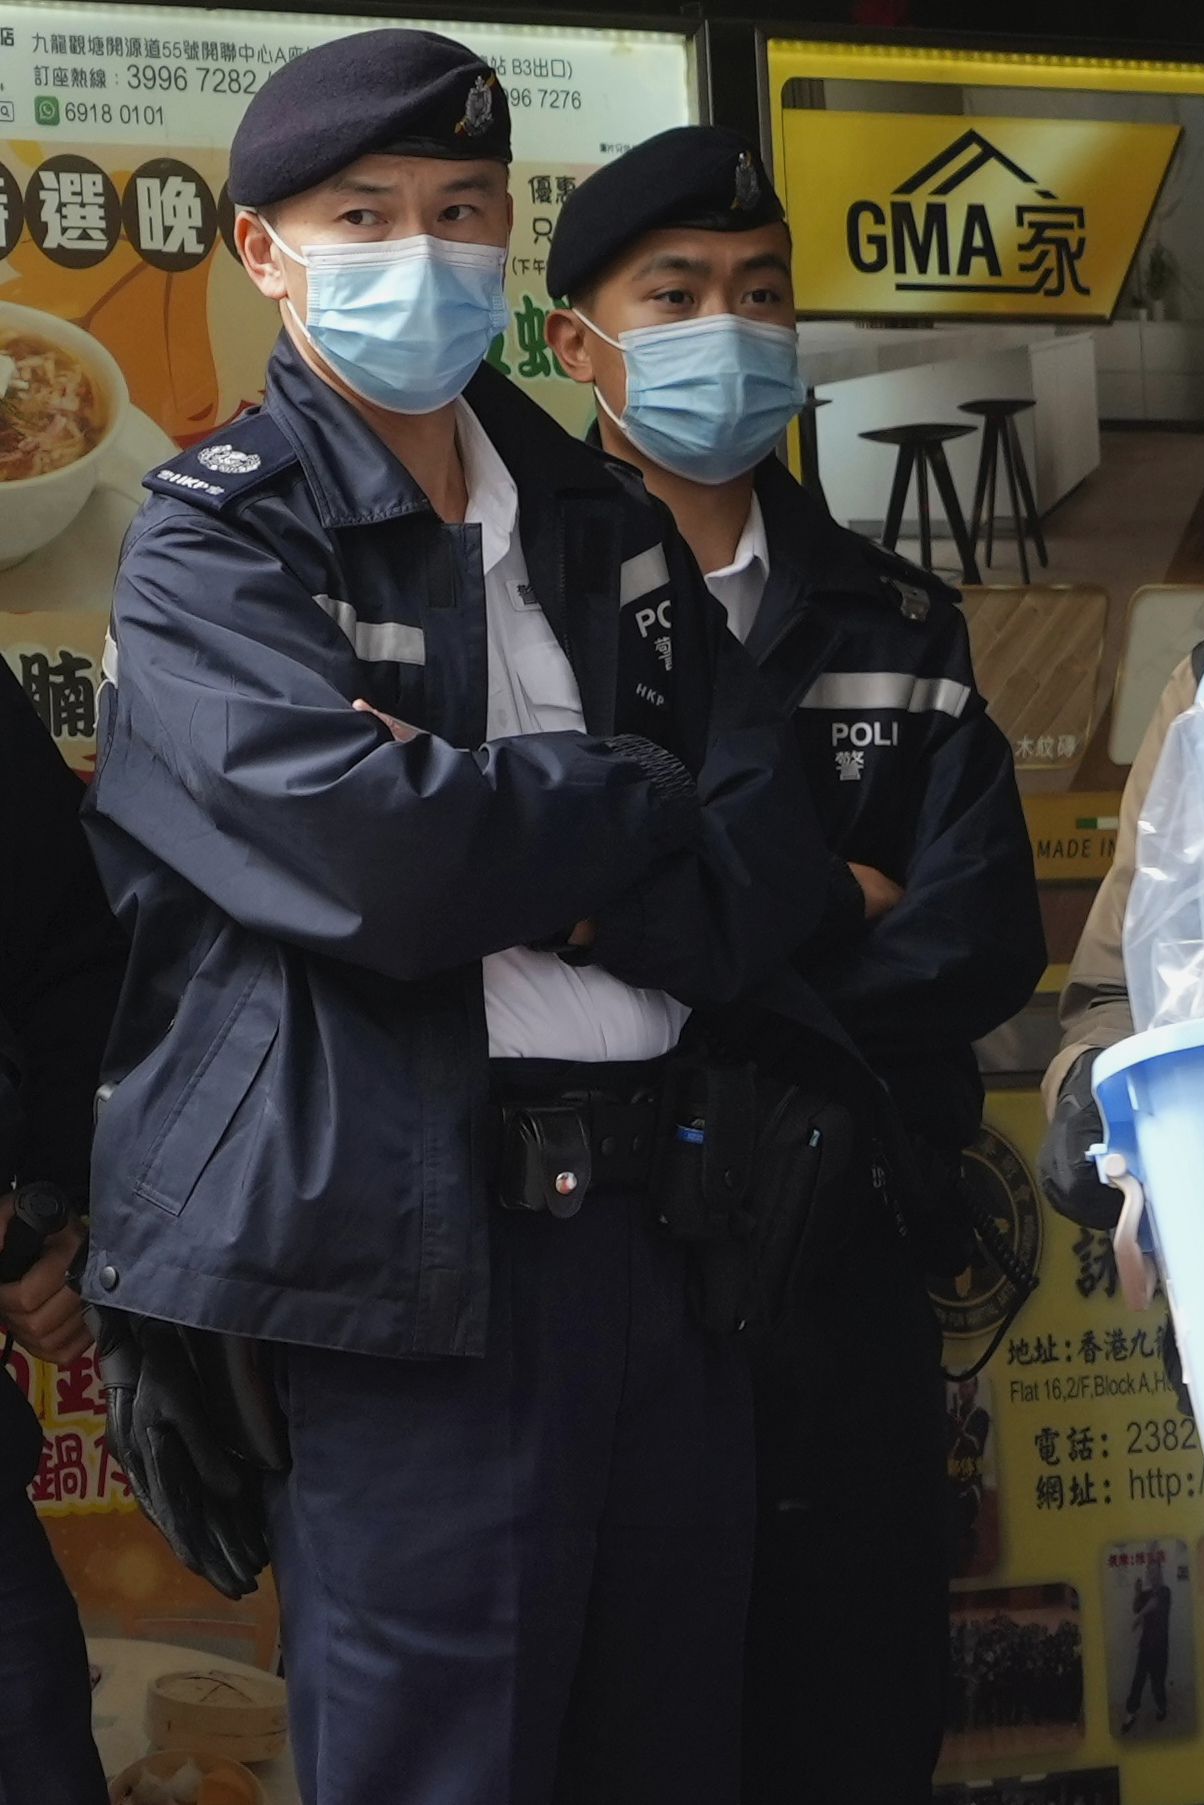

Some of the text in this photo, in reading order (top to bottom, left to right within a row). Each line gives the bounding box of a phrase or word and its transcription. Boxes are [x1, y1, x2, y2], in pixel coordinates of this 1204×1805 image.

[32, 31, 312, 64] 九龍觀塘開源道55號開聯中心A座
[127, 64, 188, 91] 3996
[196, 67, 256, 94] 7282
[539, 90, 582, 110] 7276
[65, 102, 164, 126] 6918 0101
[846, 199, 1002, 276] GMA
[834, 749, 866, 781] 警
[1037, 838, 1092, 860] MADE
[1009, 1379, 1039, 1403] Flat
